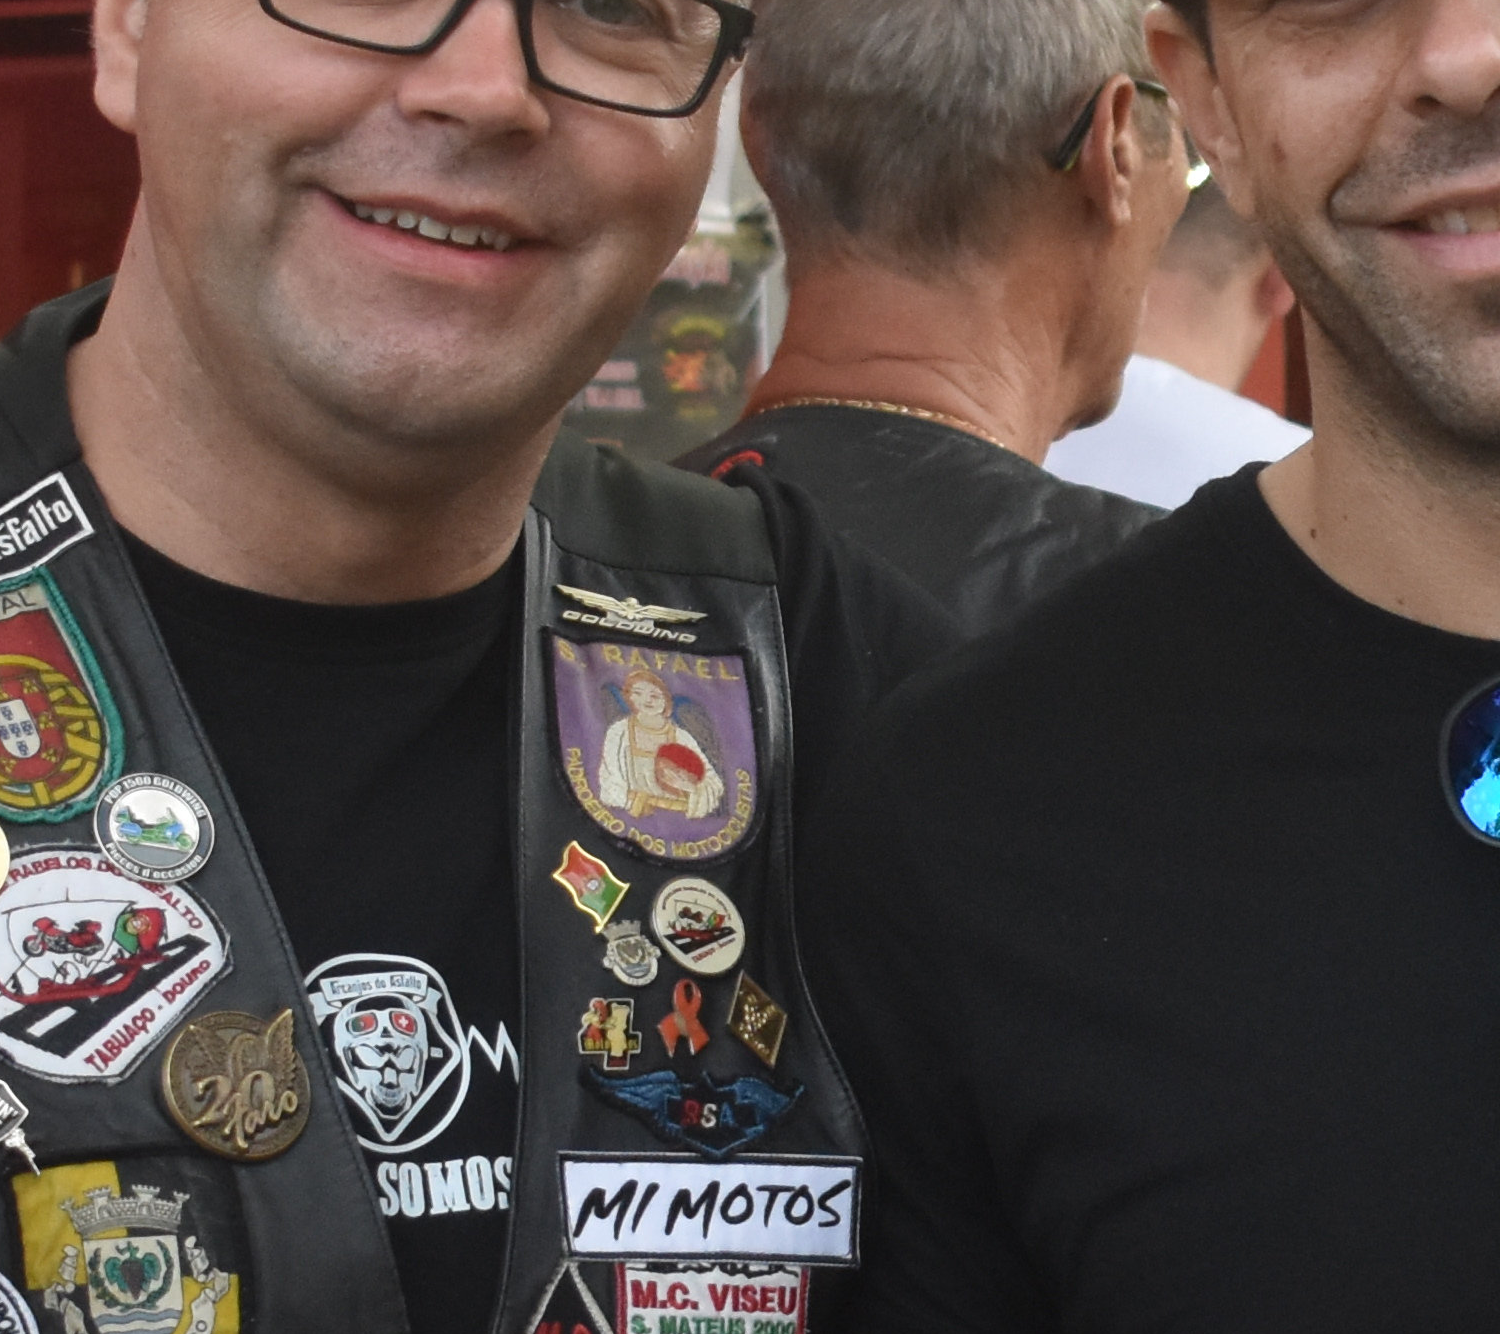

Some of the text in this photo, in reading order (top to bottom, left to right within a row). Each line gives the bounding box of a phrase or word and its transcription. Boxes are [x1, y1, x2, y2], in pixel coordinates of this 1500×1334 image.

[561, 609, 698, 644] GOLDWING
[602, 643, 740, 681] RAFAEL
[123, 775, 152, 788] 1500
[153, 776, 207, 819] GOLDWING
[566, 746, 752, 859] PADROEIRO DOS MOTOCICLISTAS
[9, 856, 92, 882] RABELOS
[132, 877, 204, 930] FALTO
[330, 974, 422, 996] Arcanjos do Asfalto
[83, 1007, 156, 1074] TABUAÇO
[162, 959, 212, 1005] DOURO
[376, 1154, 513, 1218] SOMOS
[572, 1178, 852, 1241] MI MOTOS
[630, 1279, 798, 1315] M.C. VISEU
